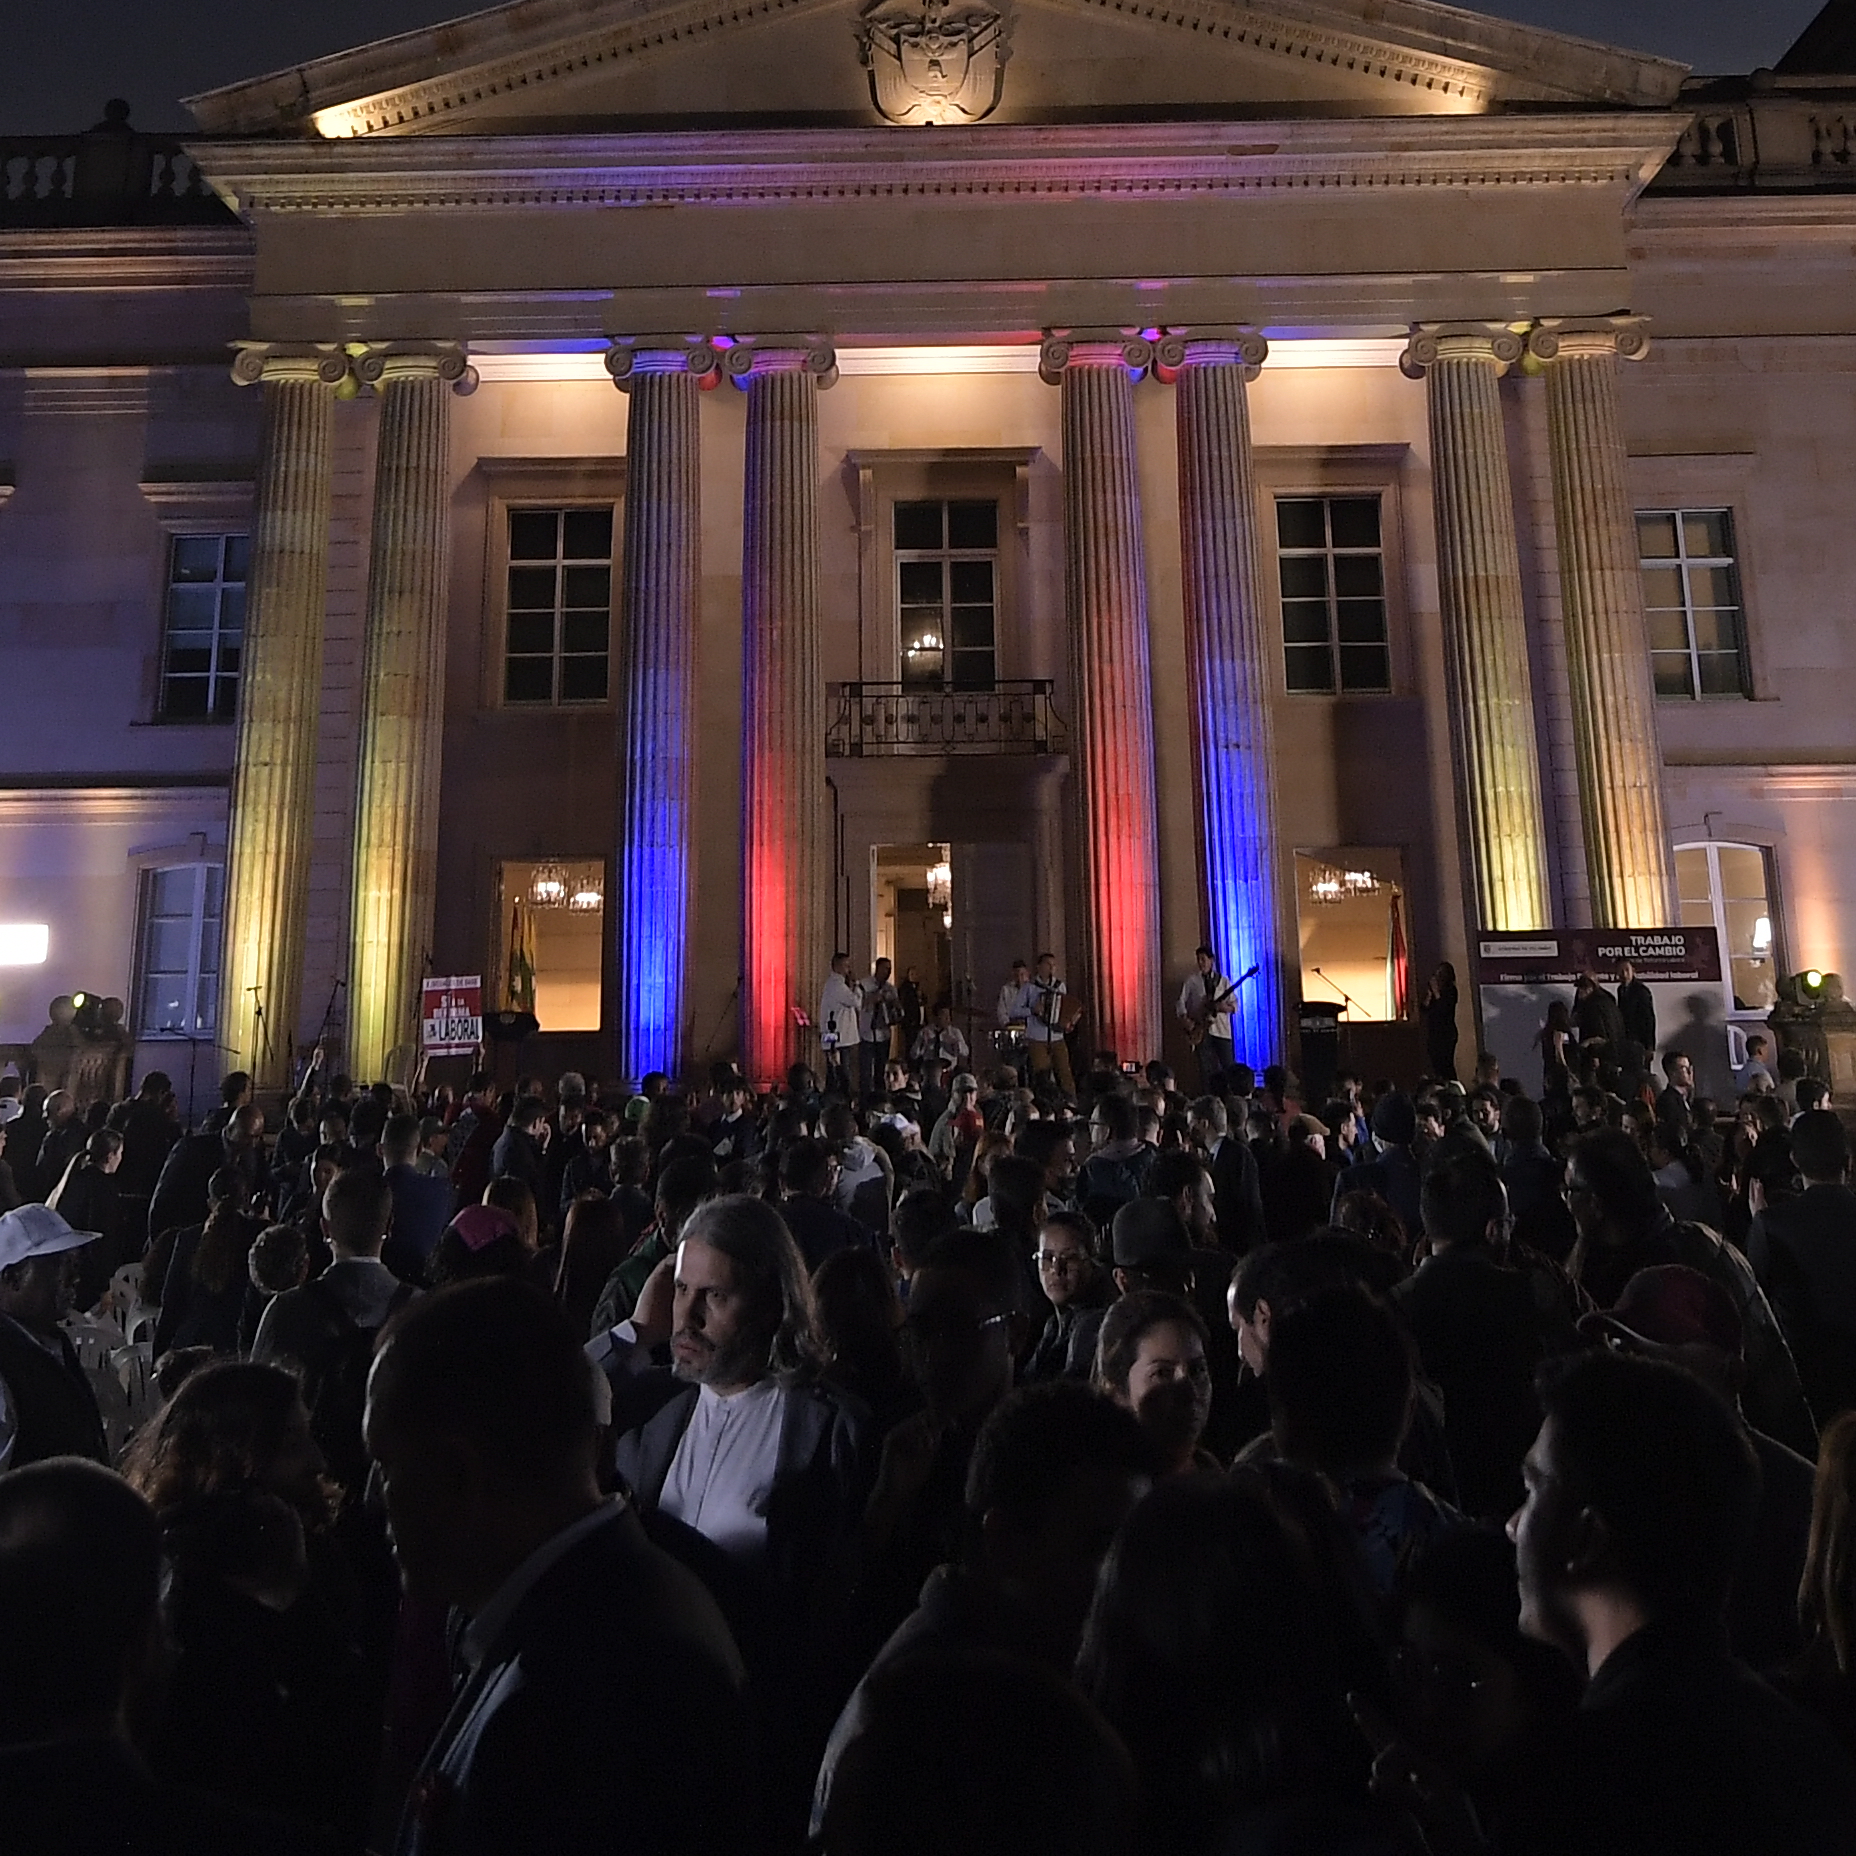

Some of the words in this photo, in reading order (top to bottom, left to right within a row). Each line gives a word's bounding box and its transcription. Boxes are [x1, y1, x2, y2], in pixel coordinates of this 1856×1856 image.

[1629, 935, 1685, 946] TRABAJO
[1597, 947, 1623, 957] POR
[1624, 946, 1638, 957] EL
[1639, 945, 1686, 957] CAMBIO
[439, 1018, 479, 1040] LABORAL
